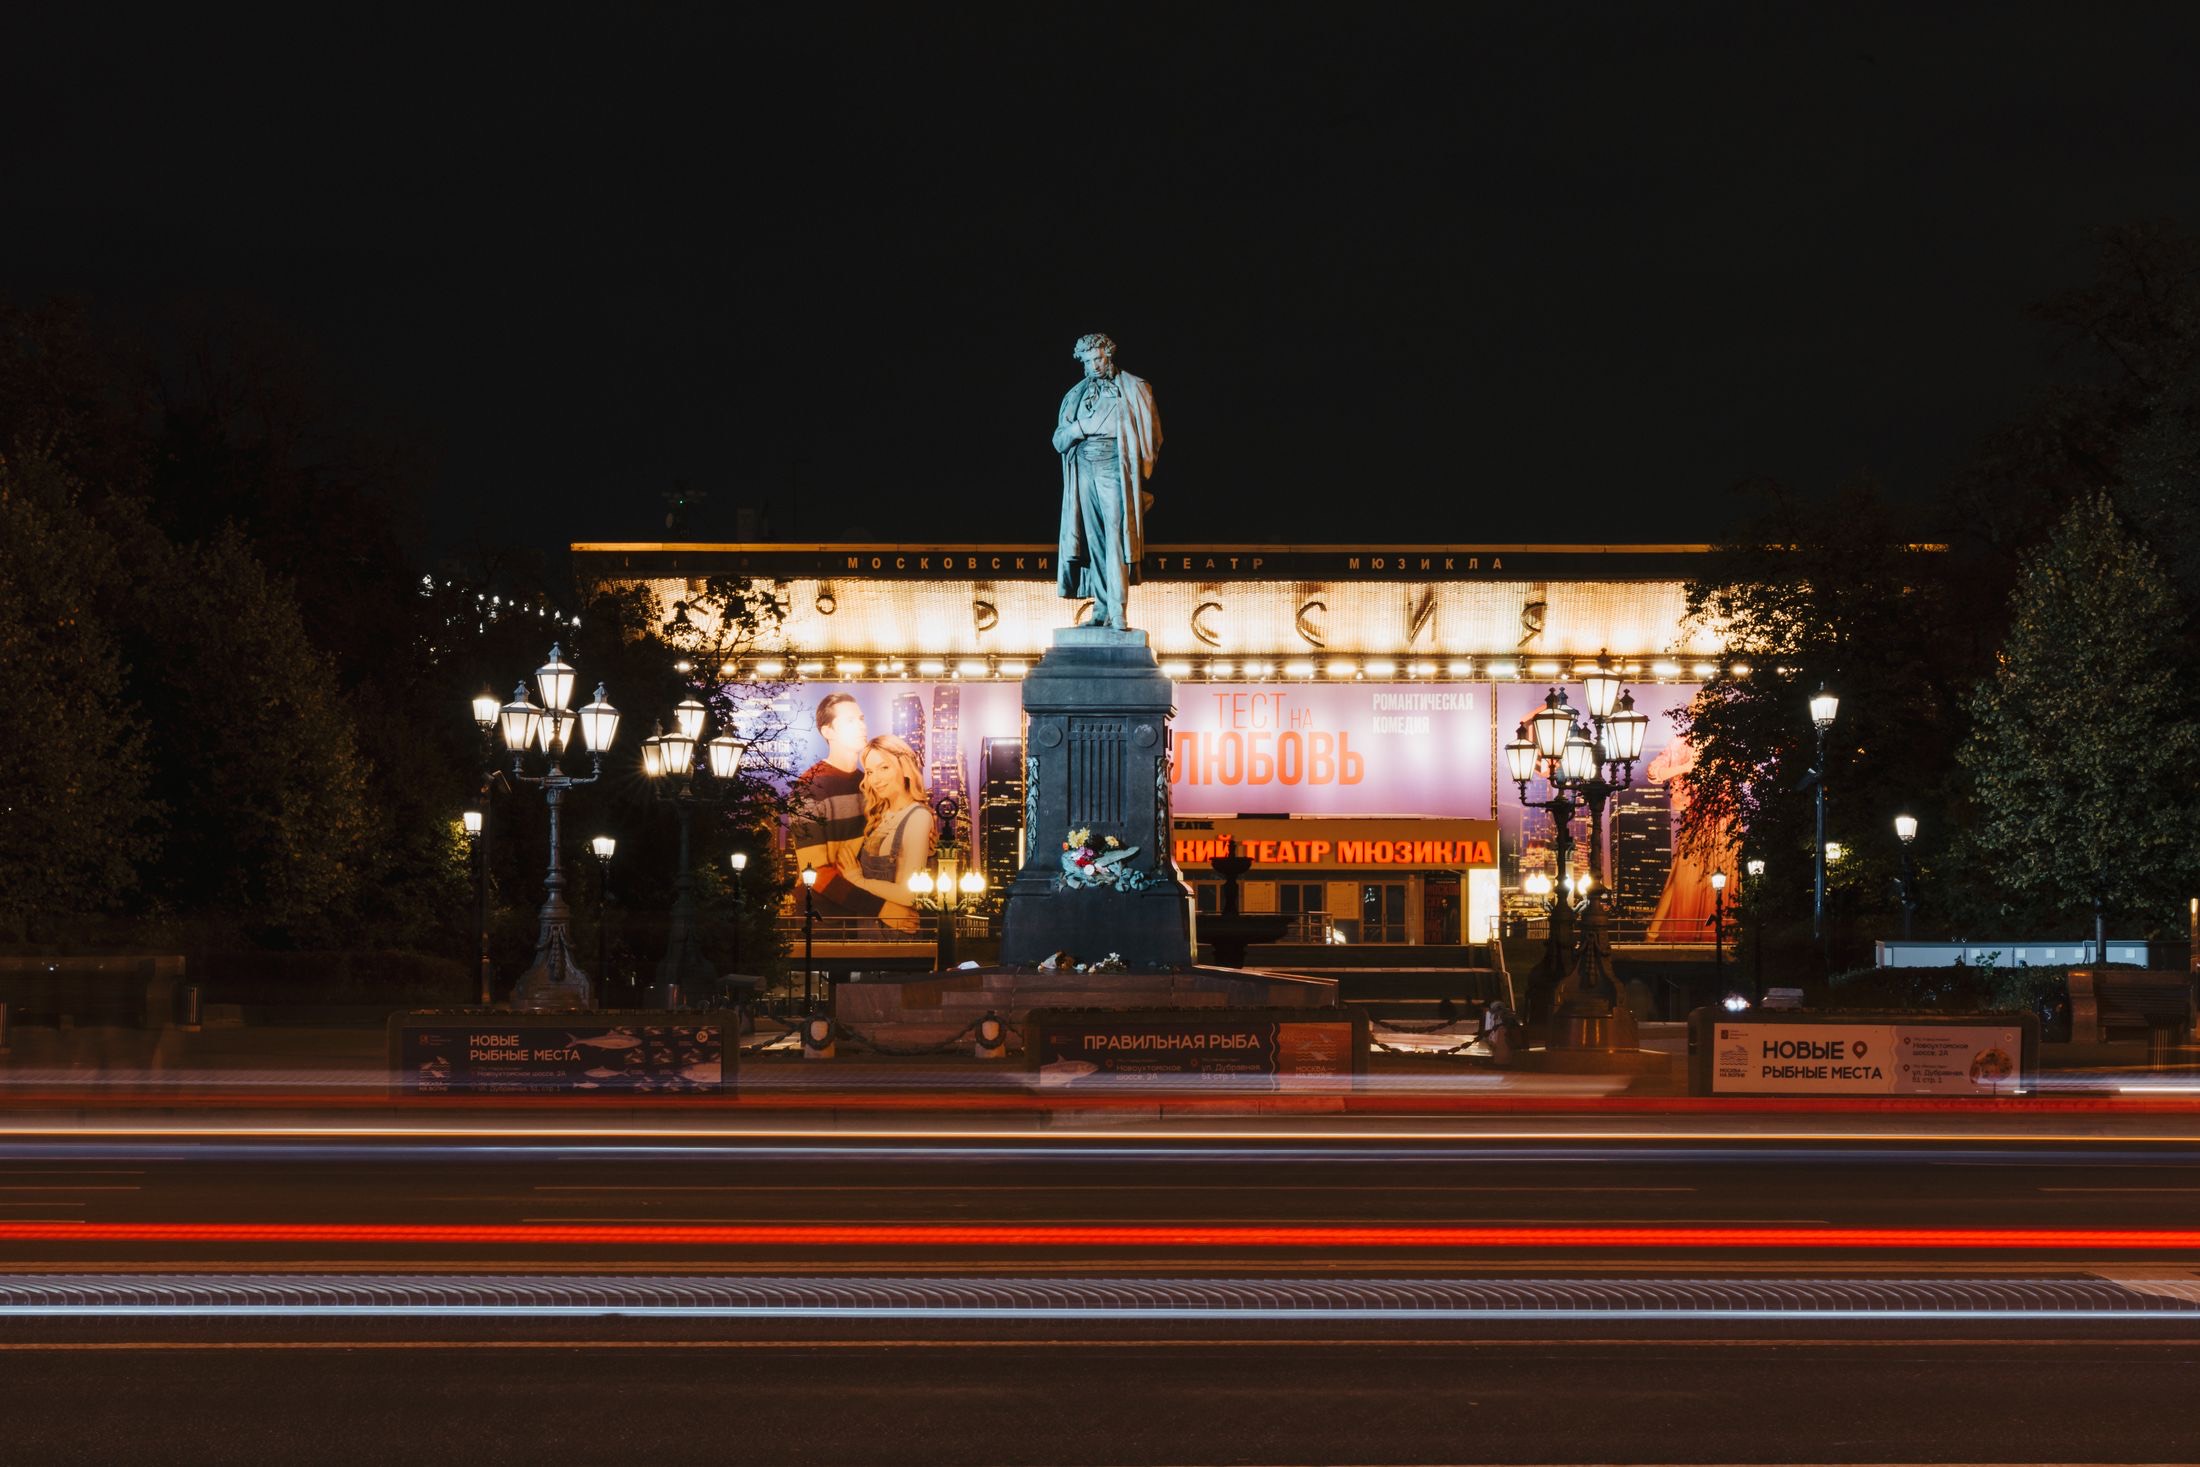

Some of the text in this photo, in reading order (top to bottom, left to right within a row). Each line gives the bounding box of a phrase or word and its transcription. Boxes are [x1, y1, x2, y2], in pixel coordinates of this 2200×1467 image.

[848, 557, 1049, 570] МОСКОВСКИ
[1158, 557, 1264, 570] ТЕАТР
[1348, 557, 1504, 570] МЮЗИКЛА
[973, 600, 1548, 648] РССИЯ
[1212, 692, 1313, 729] ТЕСТ НА
[1372, 693, 1474, 711] РОМАНТИЧЕСКАЯ
[1372, 716, 1430, 735] КОМЕДИЯ
[1172, 731, 1364, 786] ЛЮБОВЬ
[1241, 840, 1332, 864] ТЕАТР
[1337, 840, 1493, 864] МЮЗИКЛА
[470, 1034, 520, 1047] НОВЫЕ
[1084, 1034, 1206, 1050] ПРАВИЛЬНАЯ
[1209, 1033, 1261, 1049] РЫБА
[469, 1049, 582, 1061] РЫБНЫЕ МЕСТА
[1762, 1041, 1844, 1060] НОВЫЕ
[1762, 1066, 1882, 1079] РЫБНЫЕ МЕСТА
